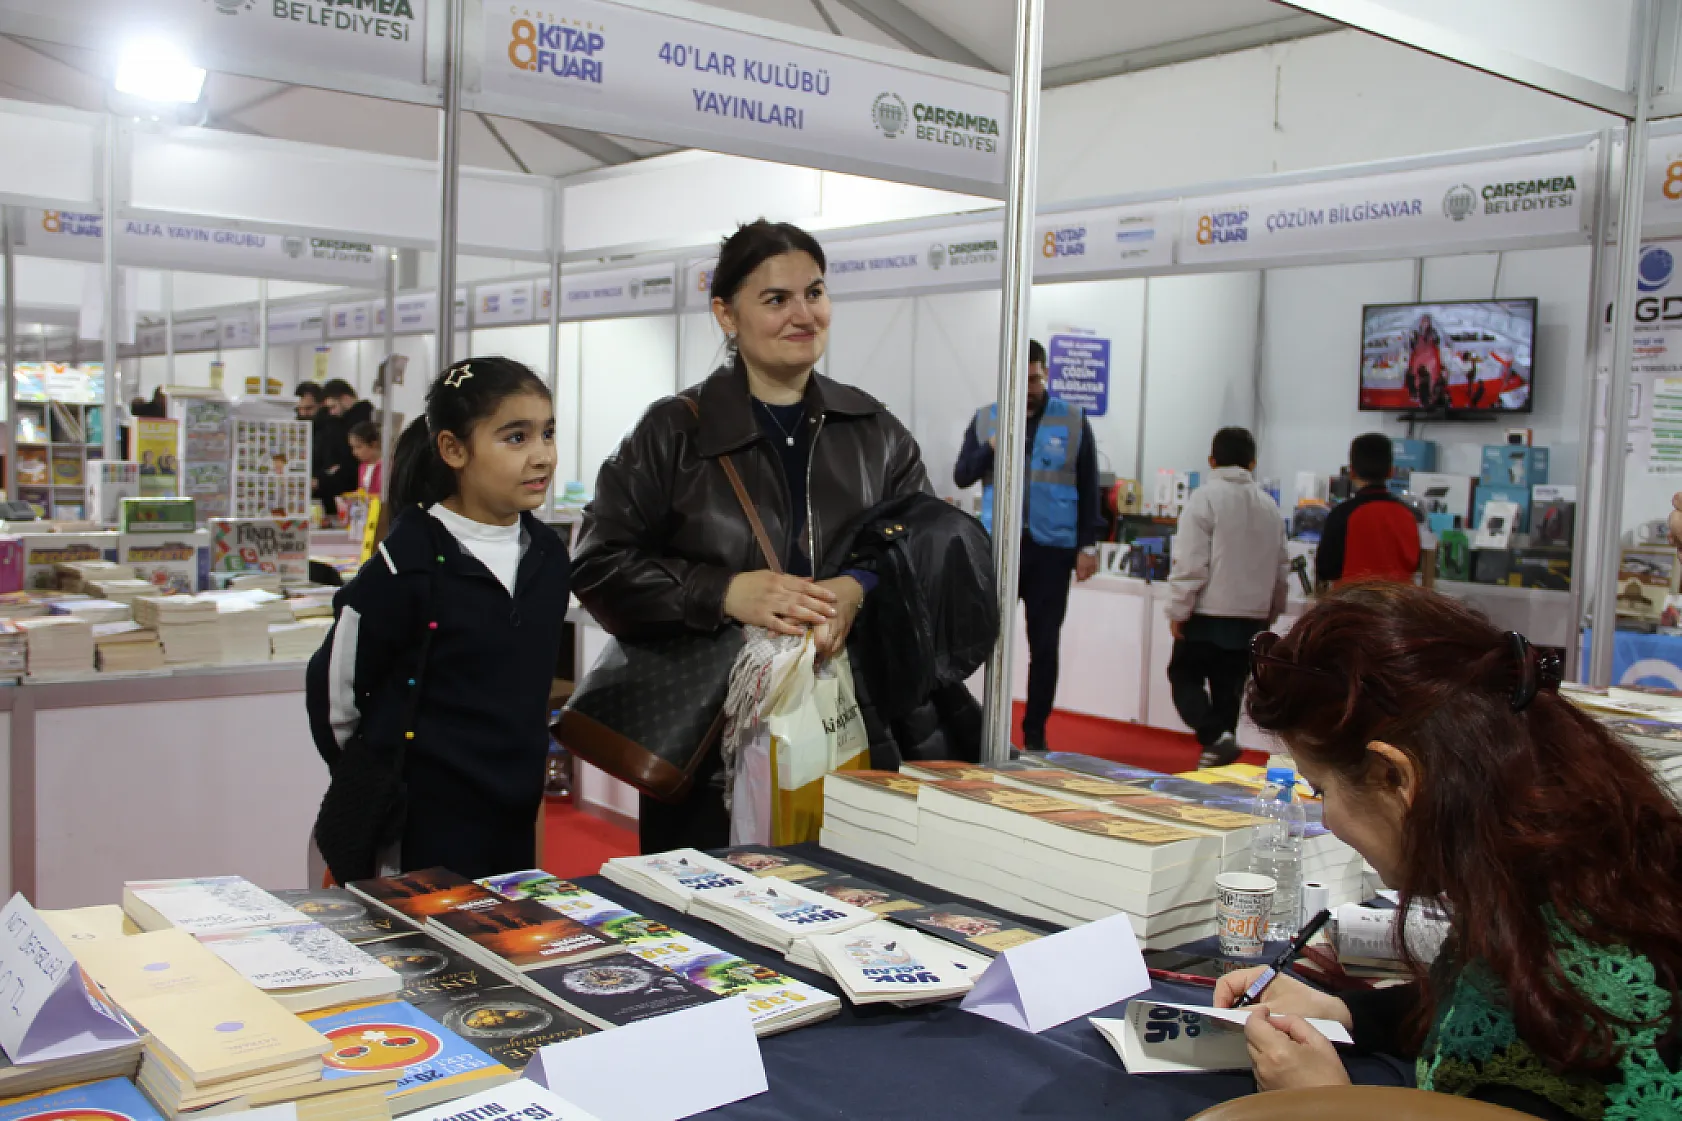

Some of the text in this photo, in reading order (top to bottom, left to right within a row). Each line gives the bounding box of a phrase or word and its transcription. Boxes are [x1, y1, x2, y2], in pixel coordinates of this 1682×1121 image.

[538, 22, 605, 56] KİTAP
[537, 50, 603, 83] FUARI
[658, 41, 831, 96] 40'LAR KULÜBÜ
[692, 88, 804, 130] YAYINLARI
[913, 102, 1000, 137] ÇARŞAMBA
[916, 124, 997, 154] BELEDİYESİ
[1481, 175, 1577, 200] ÇARŞAMBA
[1212, 210, 1249, 228] KİTAP
[1266, 198, 1423, 233] ÇÖZÜM BİLGİSAYAR
[126, 221, 266, 248] ALFA YAYIN GRUBU
[1212, 228, 1248, 244] FUARI
